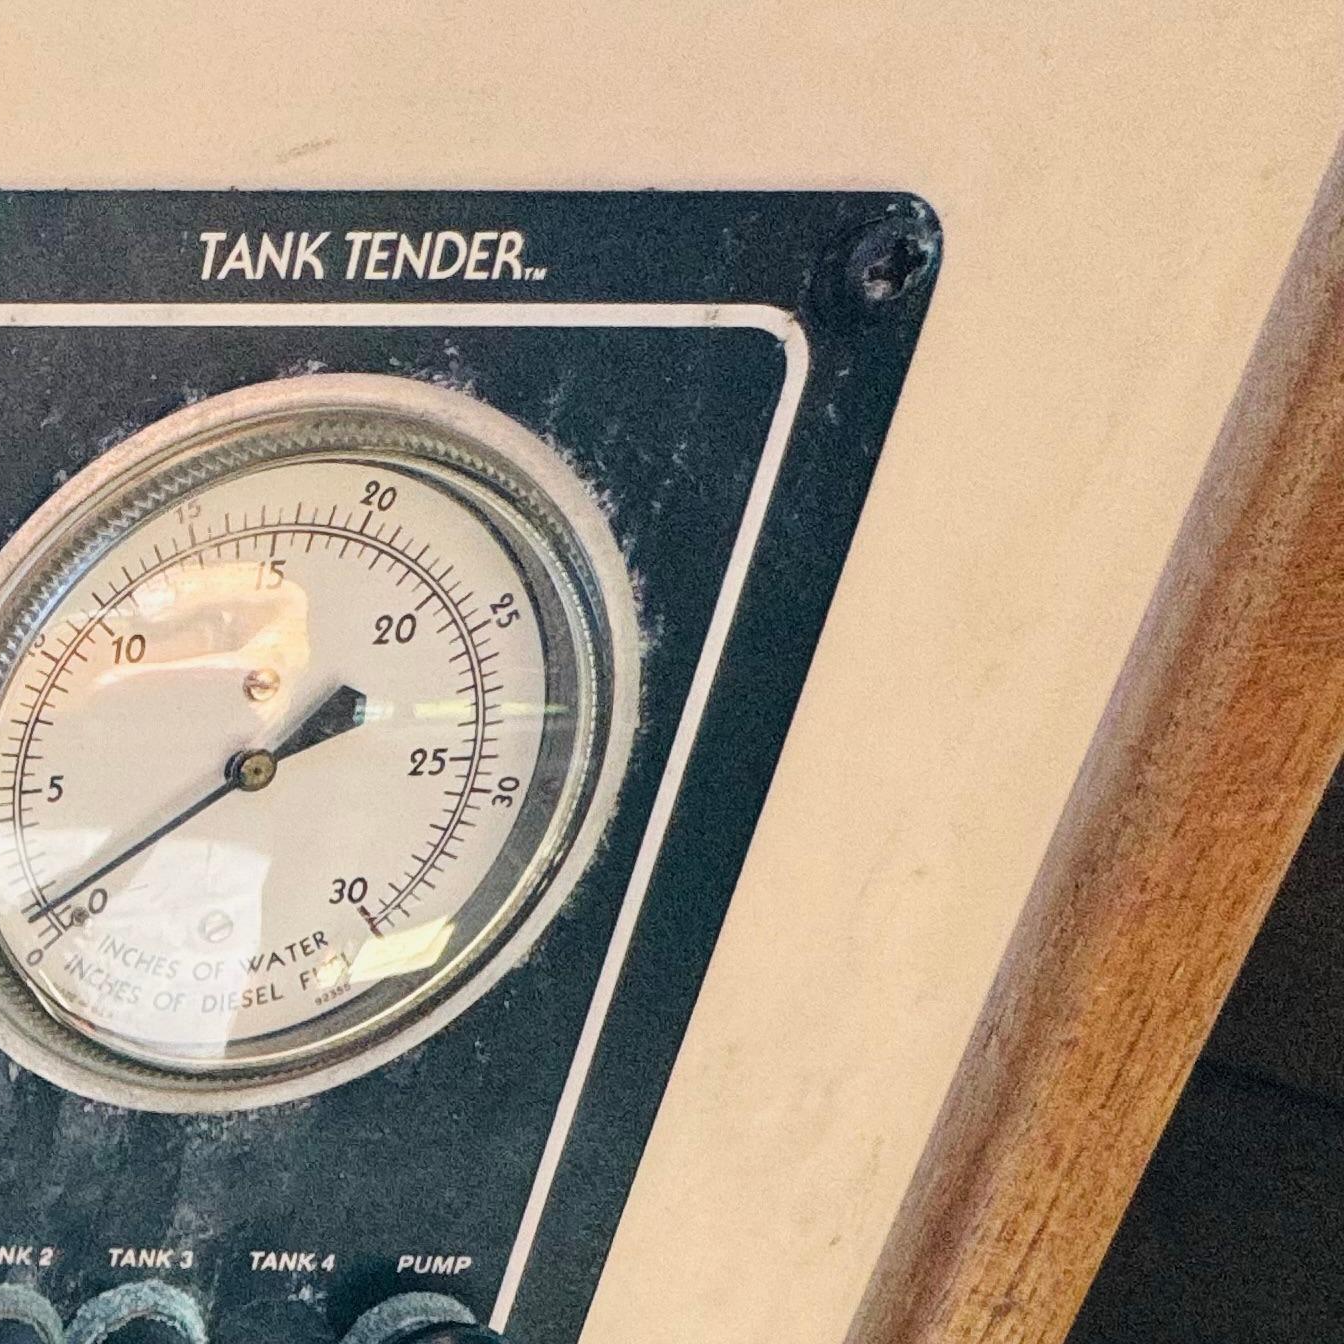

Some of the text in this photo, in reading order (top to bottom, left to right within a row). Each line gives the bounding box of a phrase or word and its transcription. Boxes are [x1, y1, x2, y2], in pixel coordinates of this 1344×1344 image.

[199, 231, 331, 281] TANK
[344, 230, 524, 281] TENDER
[360, 480, 397, 511] 20
[254, 560, 286, 591] 15
[489, 592, 520, 629] 25
[372, 613, 417, 645] 20
[111, 633, 146, 664] 10
[407, 748, 448, 776] 25
[47, 775, 64, 802] 5
[491, 776, 520, 808] 30
[87, 888, 108, 915] 0
[329, 876, 368, 904] 30
[27, 948, 44, 966] 0
[97, 930, 329, 982] INCHES OF WATER
[64, 954, 142, 1005] INCHES
[152, 991, 181, 1014] OF
[201, 986, 284, 1015] DIESEL
[38, 1247, 56, 1266] 2
[108, 1247, 194, 1270] TANK 3
[248, 1250, 336, 1272] TANK 4
[396, 1255, 473, 1276] PUMP
